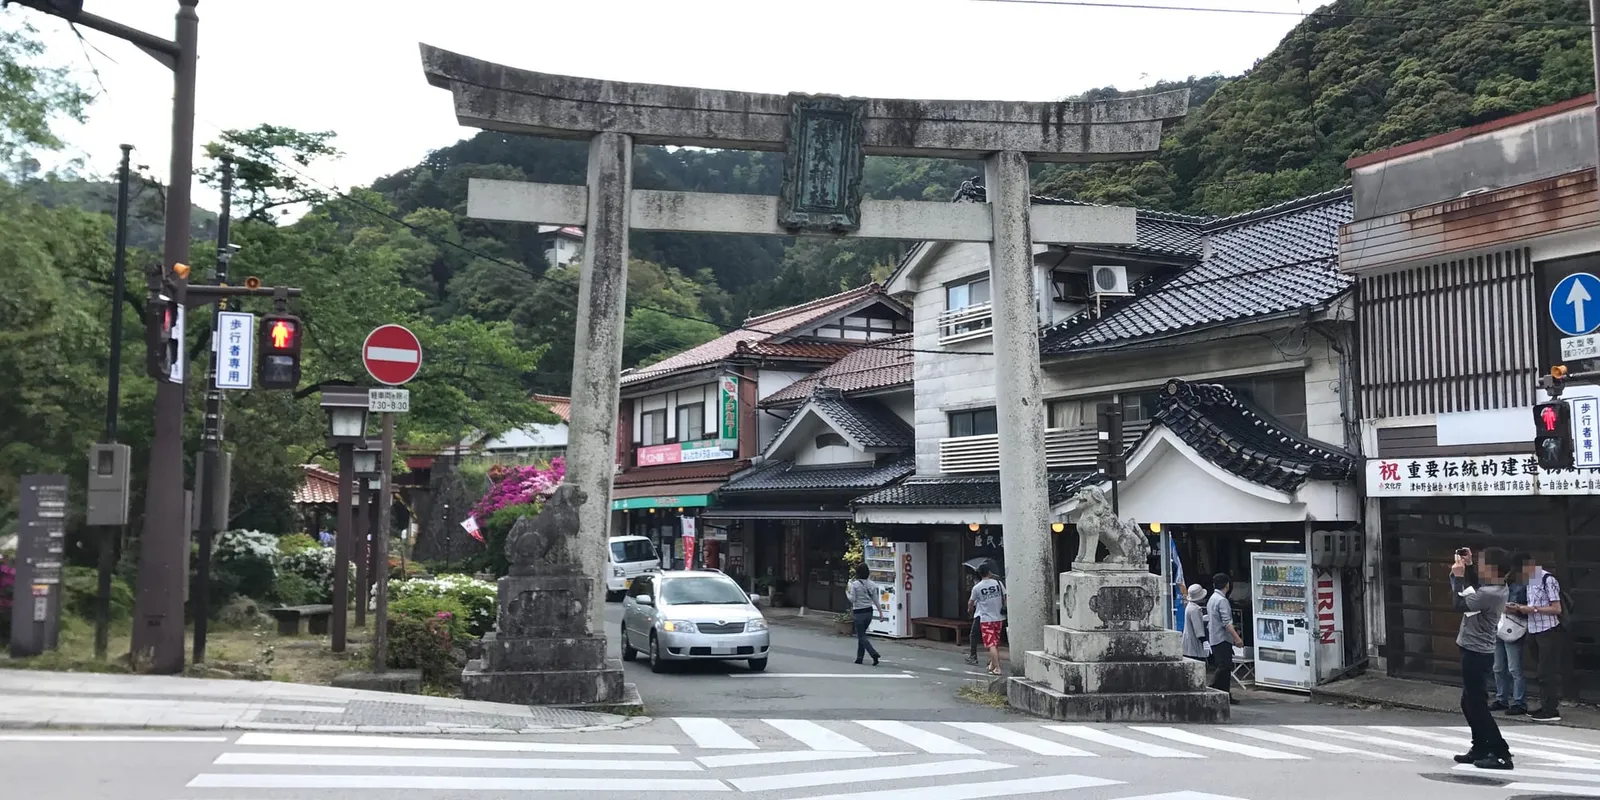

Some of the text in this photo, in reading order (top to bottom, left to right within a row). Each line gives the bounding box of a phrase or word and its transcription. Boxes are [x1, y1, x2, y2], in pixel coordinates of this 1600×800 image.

[228, 319, 242, 382] 歩行者専用
[1581, 403, 1593, 462] 歩行者専用
[1379, 456, 1600, 480] 祝 重要伝統的建造
[981, 585, 1000, 596] CSI
